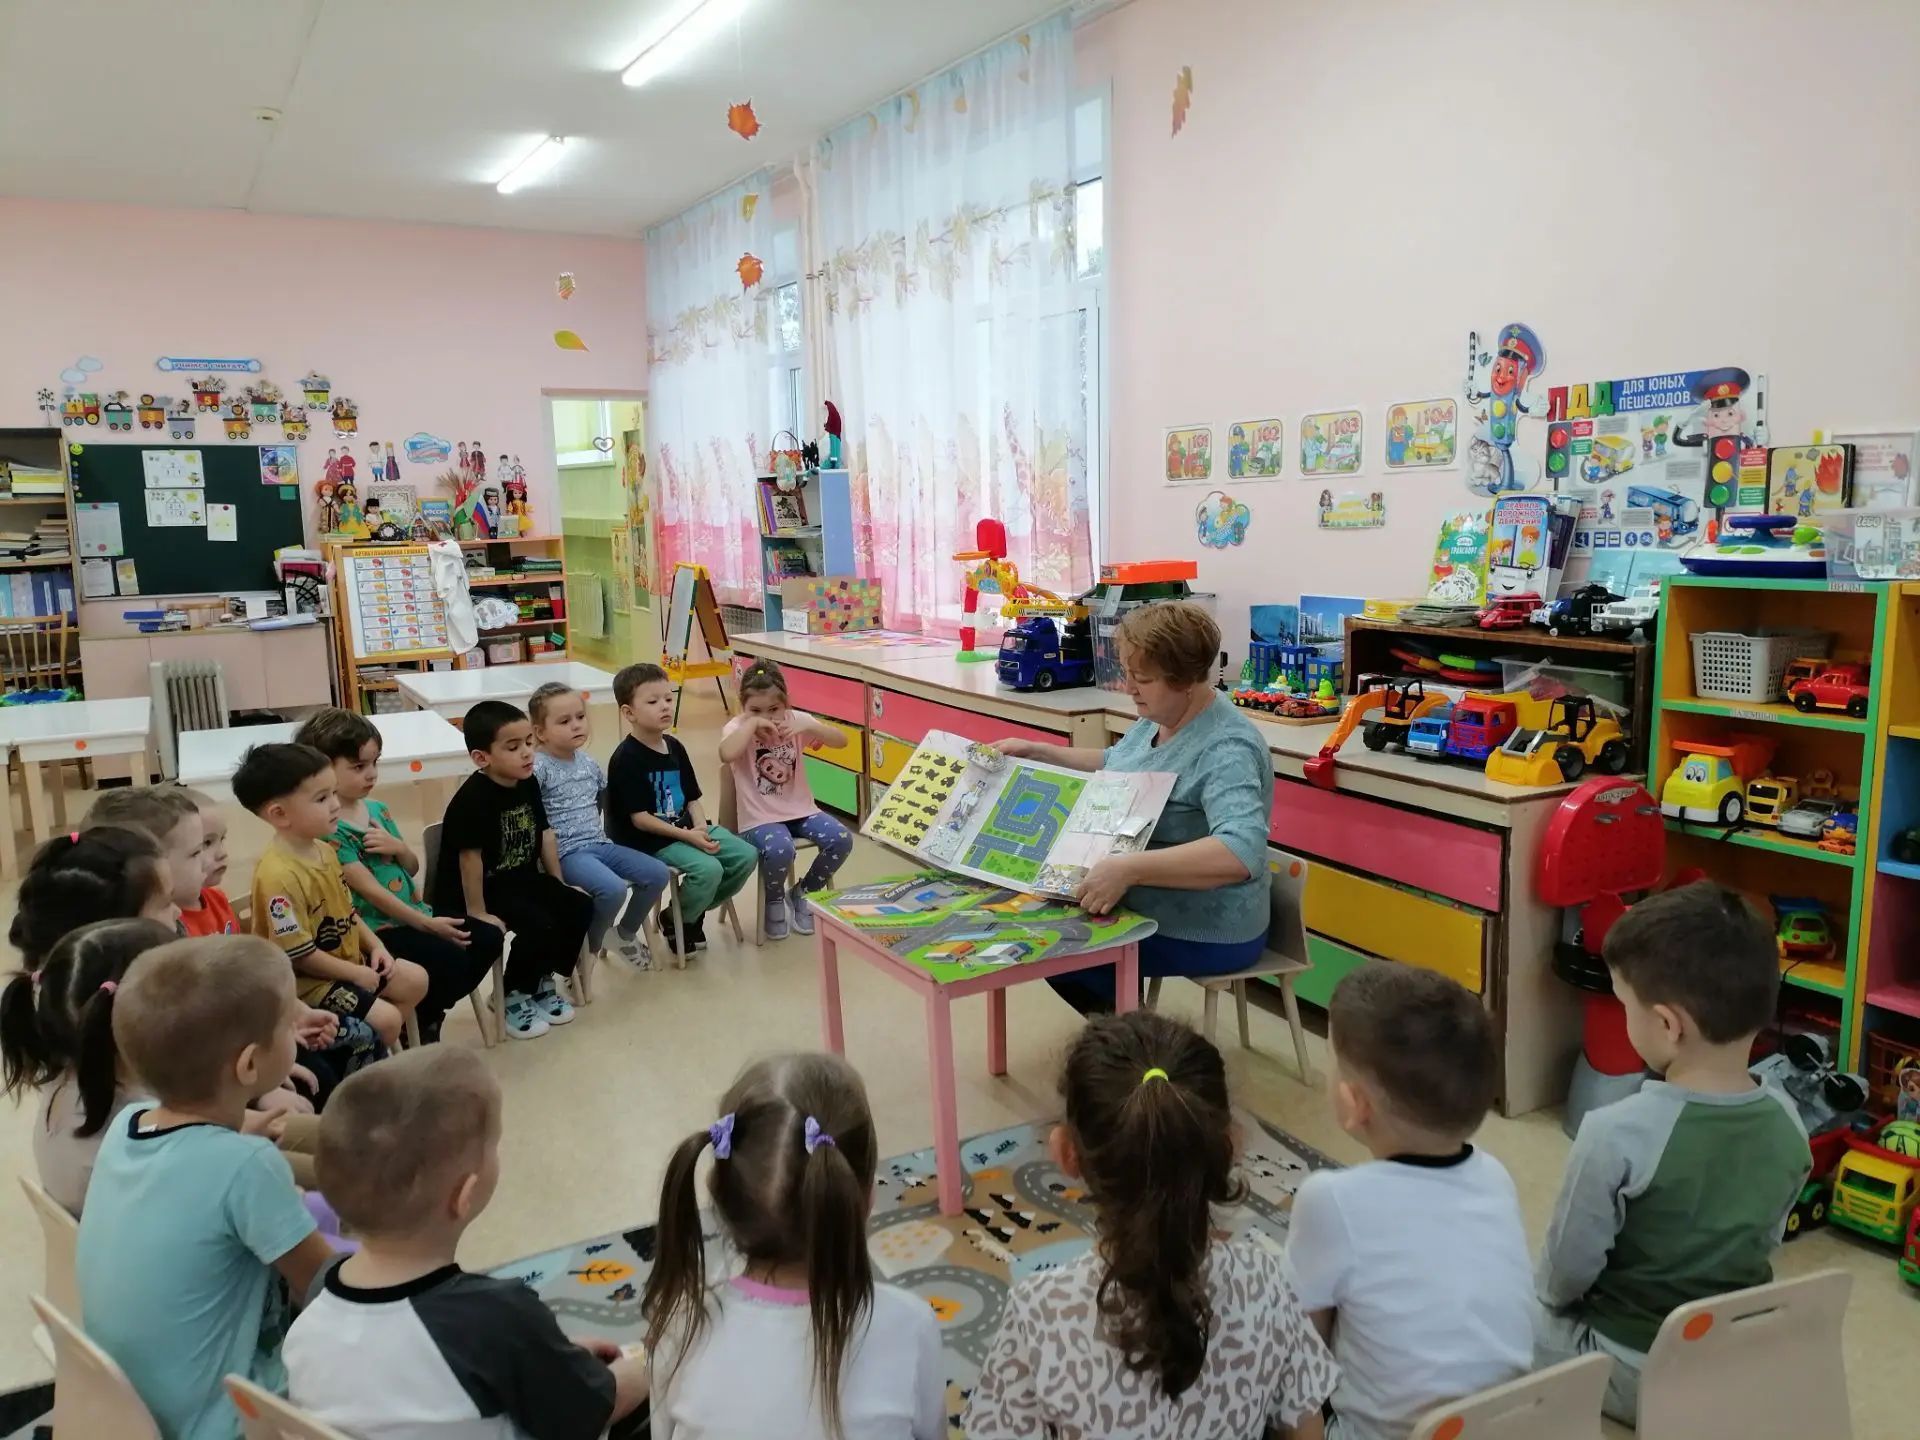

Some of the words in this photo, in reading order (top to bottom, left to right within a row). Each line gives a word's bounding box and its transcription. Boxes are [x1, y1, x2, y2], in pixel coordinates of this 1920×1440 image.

[1622, 380, 1645, 396] ДЛЯ
[1650, 374, 1686, 392] ЮНЫХ
[1547, 381, 1616, 422] ПДД
[1618, 390, 1692, 410] ПЕШЕХОДОВ
[1423, 406, 1454, 426] 104
[1257, 425, 1281, 443] 102
[1497, 510, 1545, 518] ДОРОЖНОГО
[1504, 502, 1541, 510] ПРАВИЛА
[1498, 518, 1542, 526] ДВИЖЕНИЯ
[1856, 514, 1882, 528] LEGO
[1450, 546, 1478, 555] ТРАНСПОРТ
